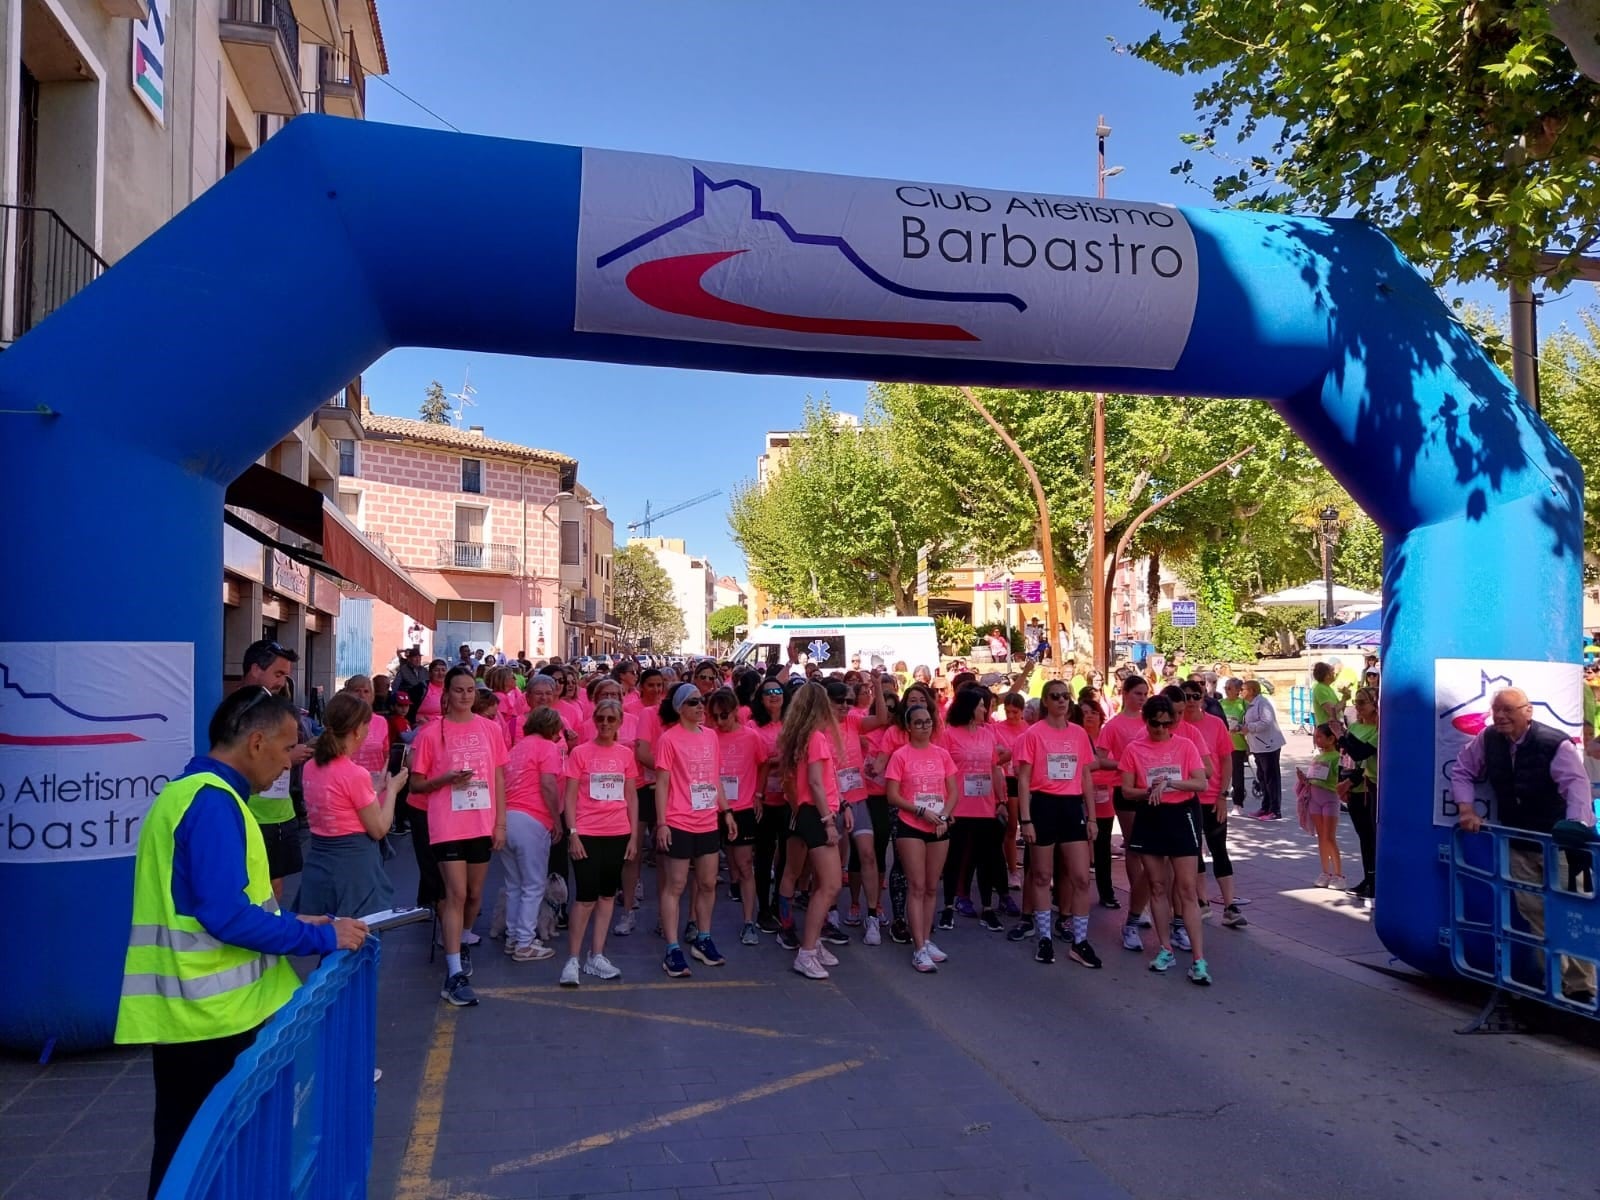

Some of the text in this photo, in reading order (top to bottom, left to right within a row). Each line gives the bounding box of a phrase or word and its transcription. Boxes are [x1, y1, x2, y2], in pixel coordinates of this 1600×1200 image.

[895, 186, 1174, 228] Club Atletismo
[902, 215, 1183, 278] Barbastro
[0, 810, 139, 850] bastr
